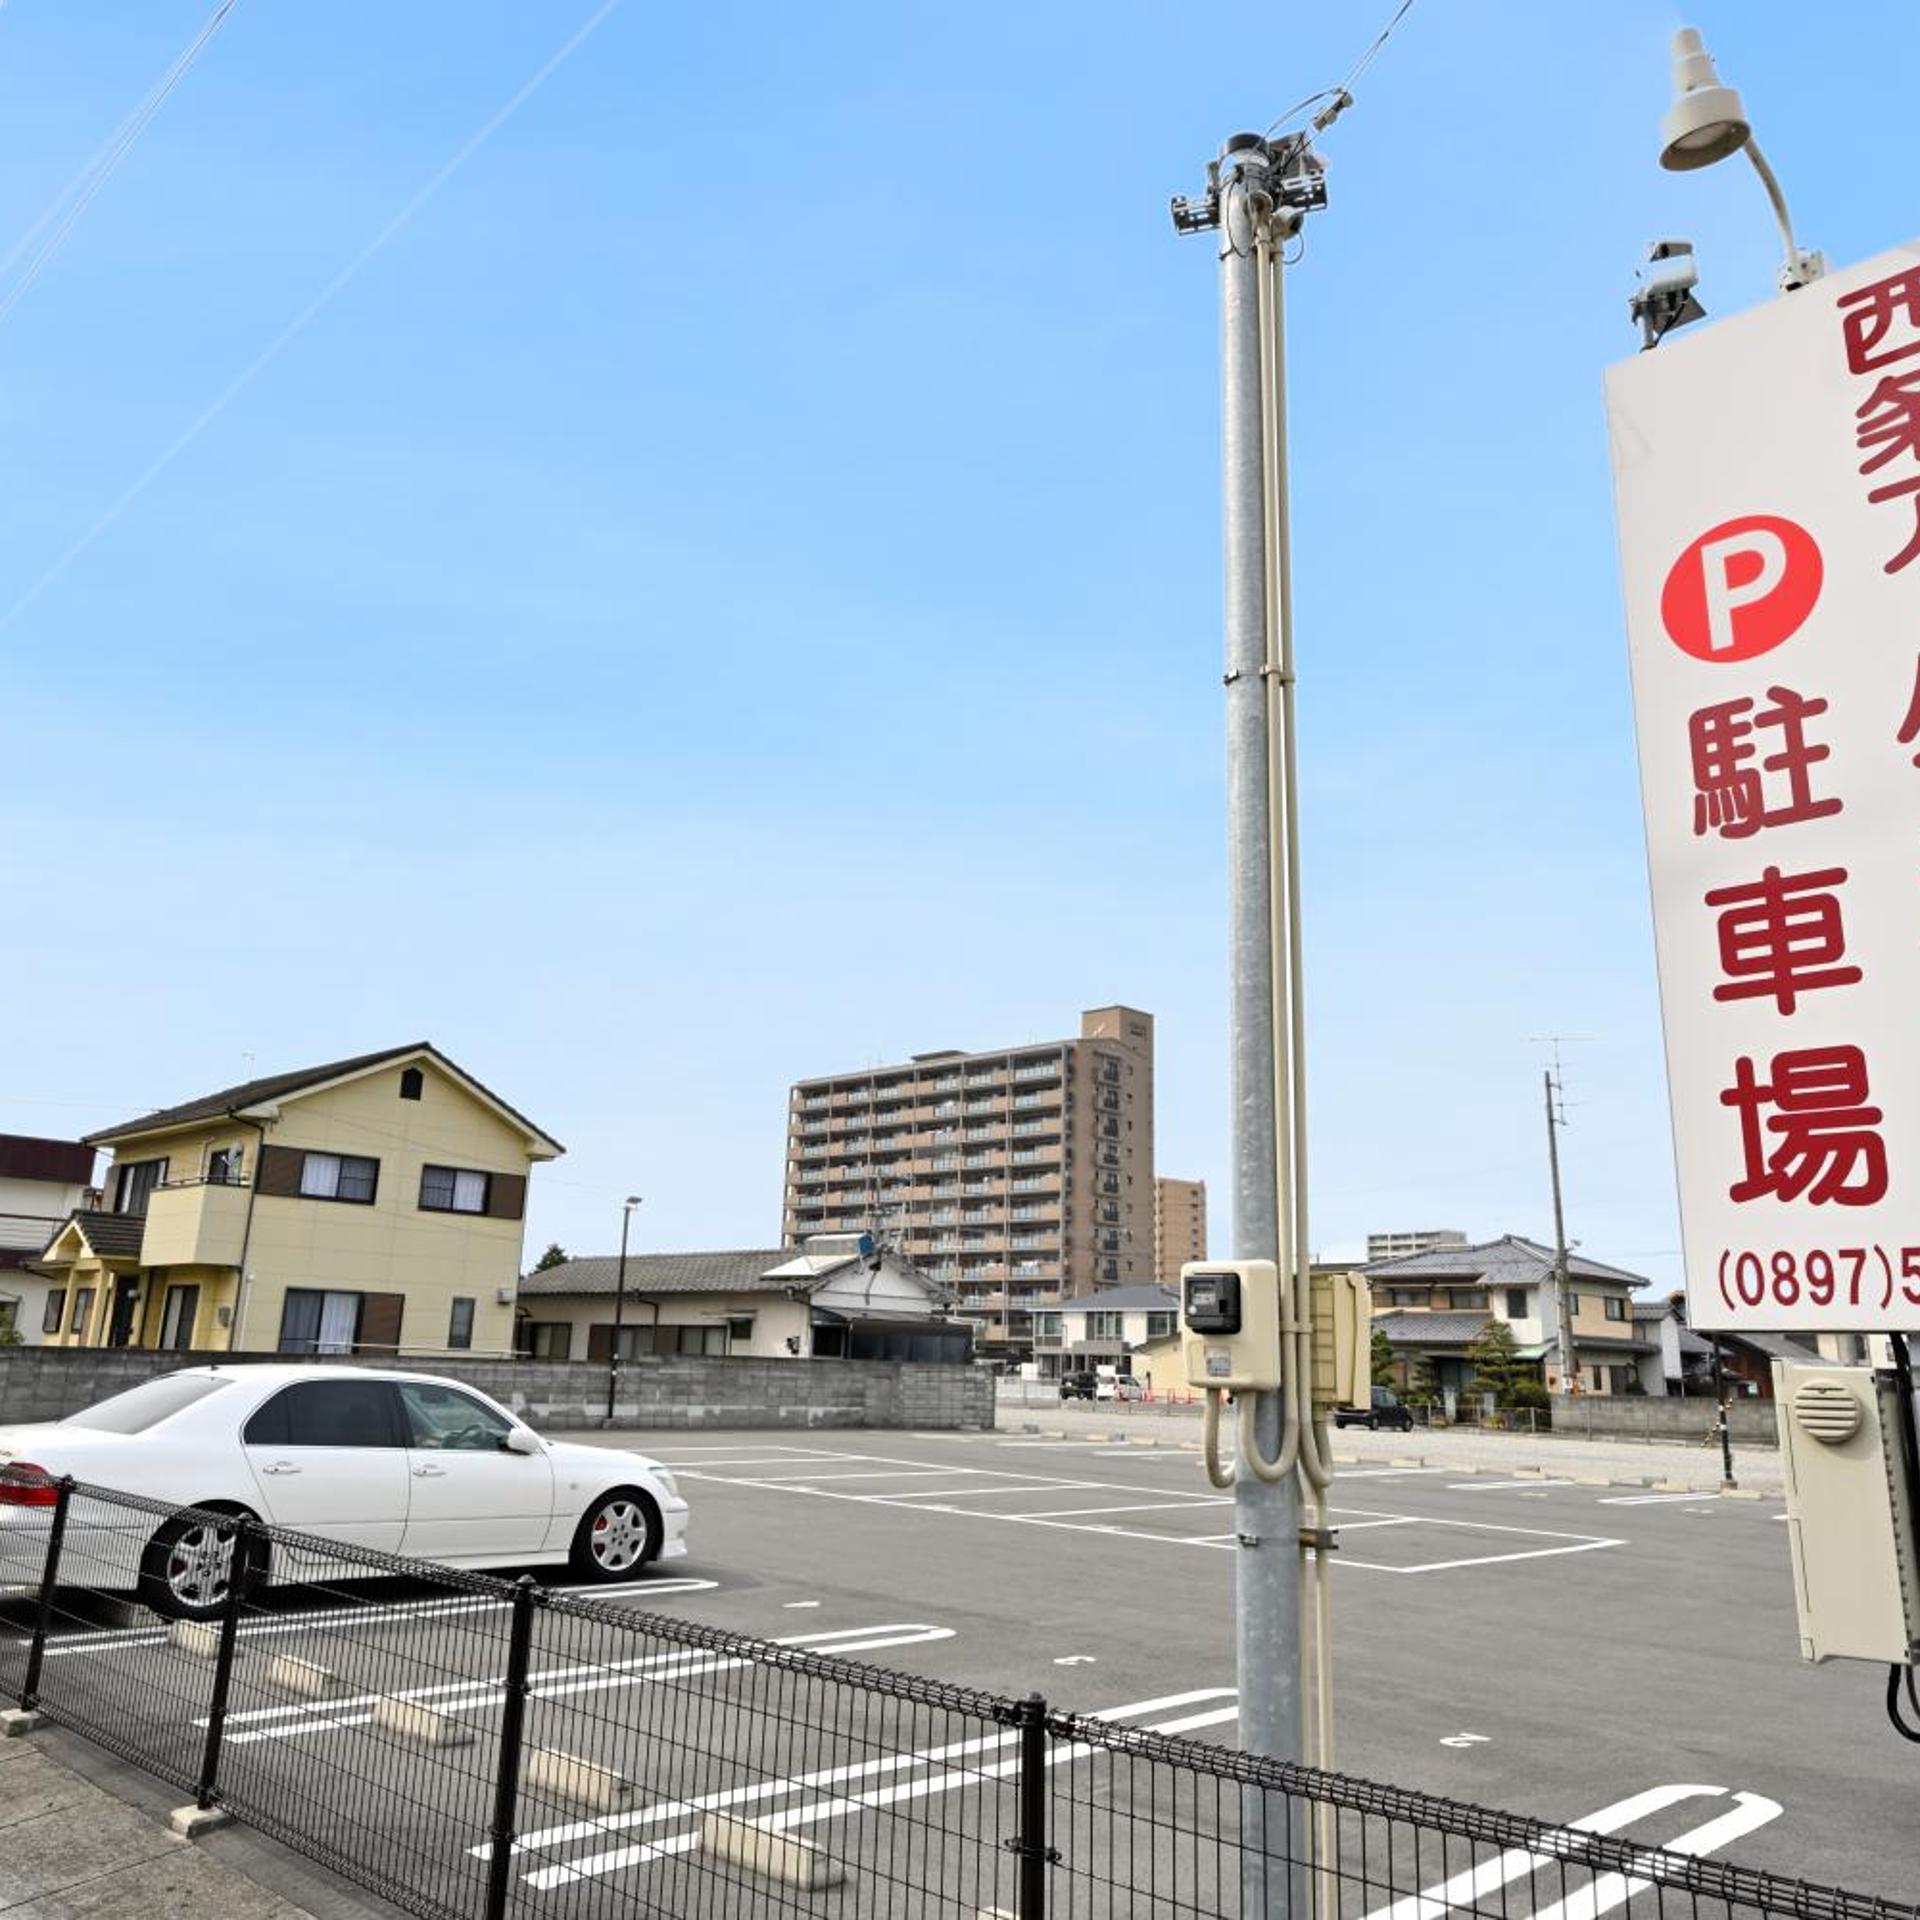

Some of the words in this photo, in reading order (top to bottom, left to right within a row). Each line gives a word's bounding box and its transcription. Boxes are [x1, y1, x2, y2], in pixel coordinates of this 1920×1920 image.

[1701, 529, 1787, 651] P
[1689, 686, 1889, 1208] 駐車場
